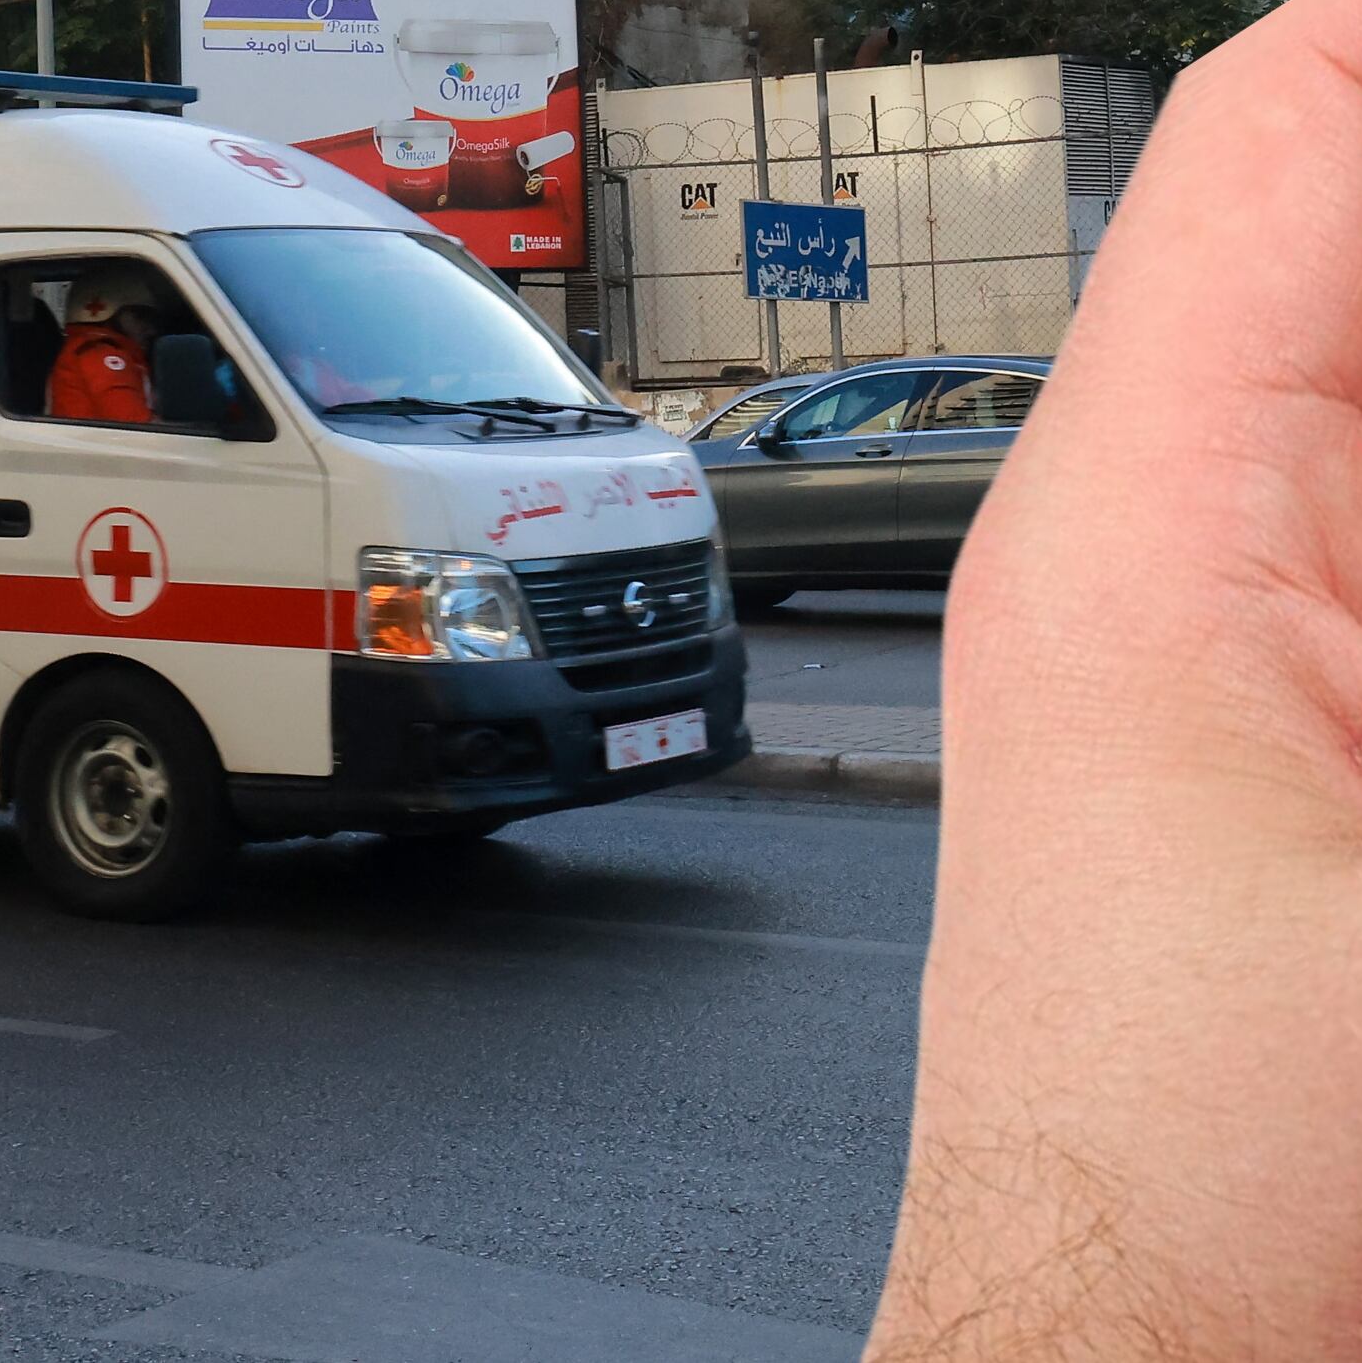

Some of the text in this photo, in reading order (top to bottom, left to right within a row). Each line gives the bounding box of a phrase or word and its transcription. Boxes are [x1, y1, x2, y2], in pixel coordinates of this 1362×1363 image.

[327, 21, 380, 34] Paints
[439, 77, 521, 114] Omega
[456, 137, 510, 154] OmegaSilk
[395, 148, 436, 167] Omega
[681, 183, 717, 210] CAT
[755, 217, 836, 259] رأس النبع
